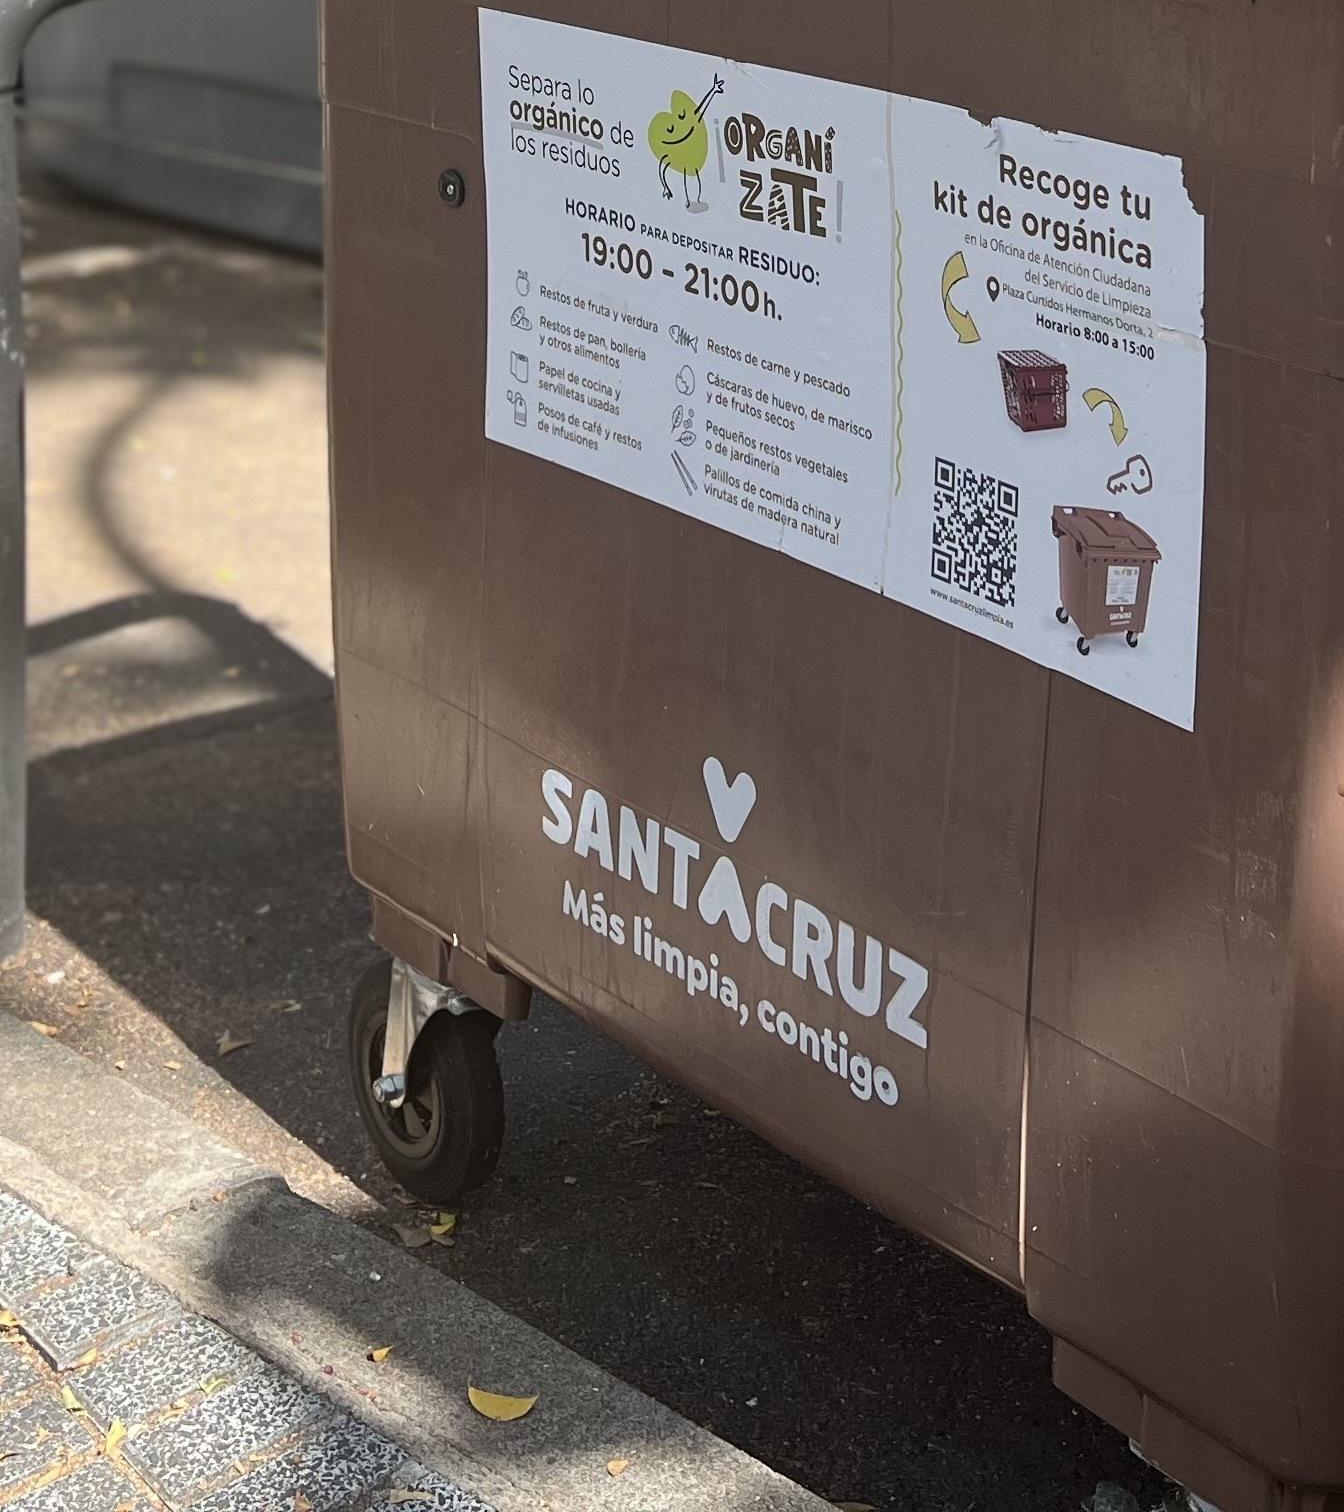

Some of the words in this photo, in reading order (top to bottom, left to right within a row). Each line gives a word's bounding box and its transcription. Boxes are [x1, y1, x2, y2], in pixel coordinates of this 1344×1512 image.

[509, 65, 571, 100] Separa
[578, 79, 594, 105] lo
[510, 100, 603, 139] orgánico
[611, 121, 634, 148] de
[511, 127, 536, 155] los
[543, 141, 620, 177] residuos
[1000, 154, 1109, 210] Recoge
[1121, 185, 1150, 221] tu
[565, 197, 636, 231] HORARIO
[640, 224, 669, 242] PARA
[672, 232, 733, 260] DEPOSITAR
[739, 246, 820, 286] RESIDUO:
[934, 181, 967, 217] kit
[978, 195, 1011, 229] de
[1022, 212, 1151, 269] orgánica
[582, 233, 652, 279] 19:00
[965, 233, 977, 245] en
[979, 235, 987, 249] la
[990, 238, 1025, 260] Oficina
[1028, 249, 1040, 264] de
[1043, 254, 1089, 278] Atención
[1093, 267, 1151, 296] Ciudadana
[540, 285, 571, 305] Restos
[574, 296, 585, 309] de
[588, 300, 610, 317] fruta
[613, 311, 618, 322] y
[621, 312, 658, 333] verdura
[1003, 283, 1024, 300] Plaza
[1027, 291, 1063, 312] Curtidos
[1066, 303, 1114, 327] Hermanos
[1148, 327, 1153, 338] 2
[1025, 269, 1039, 284] del
[1043, 274, 1083, 297] Servicio
[1086, 288, 1099, 302] de
[1103, 291, 1151, 318] Limpieza
[539, 334, 545, 345] y
[548, 337, 571, 353] otros
[574, 344, 620, 368] alimentos
[540, 316, 571, 336] Restos
[574, 327, 585, 340] de
[611, 338, 646, 361] bollería
[1036, 312, 1080, 337] Horario
[1084, 327, 1109, 345] 8:00
[1112, 338, 1118, 348] a
[1123, 338, 1154, 360] 15:00
[539, 361, 565, 378] Papel
[568, 371, 579, 384] de
[582, 377, 612, 395] cocina
[615, 389, 621, 401] y
[707, 339, 742, 362] Restos
[745, 352, 758, 367] de
[761, 358, 790, 377] carne
[794, 370, 800, 382] y
[804, 372, 850, 397] pescado
[539, 380, 584, 403] servilletas
[587, 396, 620, 415] usadas
[707, 372, 752, 398] Cáscaras
[756, 389, 769, 403] de
[772, 393, 807, 419] huevo,
[811, 408, 824, 423] de
[828, 416, 872, 440] marisco
[707, 391, 712, 403] y
[716, 393, 728, 407] de
[732, 398, 761, 419] frutos
[765, 413, 795, 431] secos
[538, 420, 549, 432] de
[552, 424, 598, 450] infusiones
[539, 402, 565, 422] Posos
[568, 414, 580, 427] de
[583, 419, 602, 435] café
[605, 429, 611, 440] y
[613, 431, 642, 450] restos
[706, 420, 756, 449] Pequeños
[759, 442, 791, 462] restos
[795, 455, 848, 483] vegetales
[706, 440, 712, 450] o
[715, 441, 728, 455] de
[730, 448, 780, 476] jardinería
[704, 484, 738, 506] virutas
[741, 497, 754, 512] de
[758, 506, 797, 528] madera
[801, 521, 839, 546] natural
[705, 464, 740, 488] Palillos
[743, 480, 756, 495] de
[759, 485, 798, 512] comida
[802, 503, 831, 524] china
[834, 516, 841, 529] y
[562, 880, 625, 945] Más
[634, 915, 750, 1027] limpia,
[758, 999, 898, 1106] contigo
